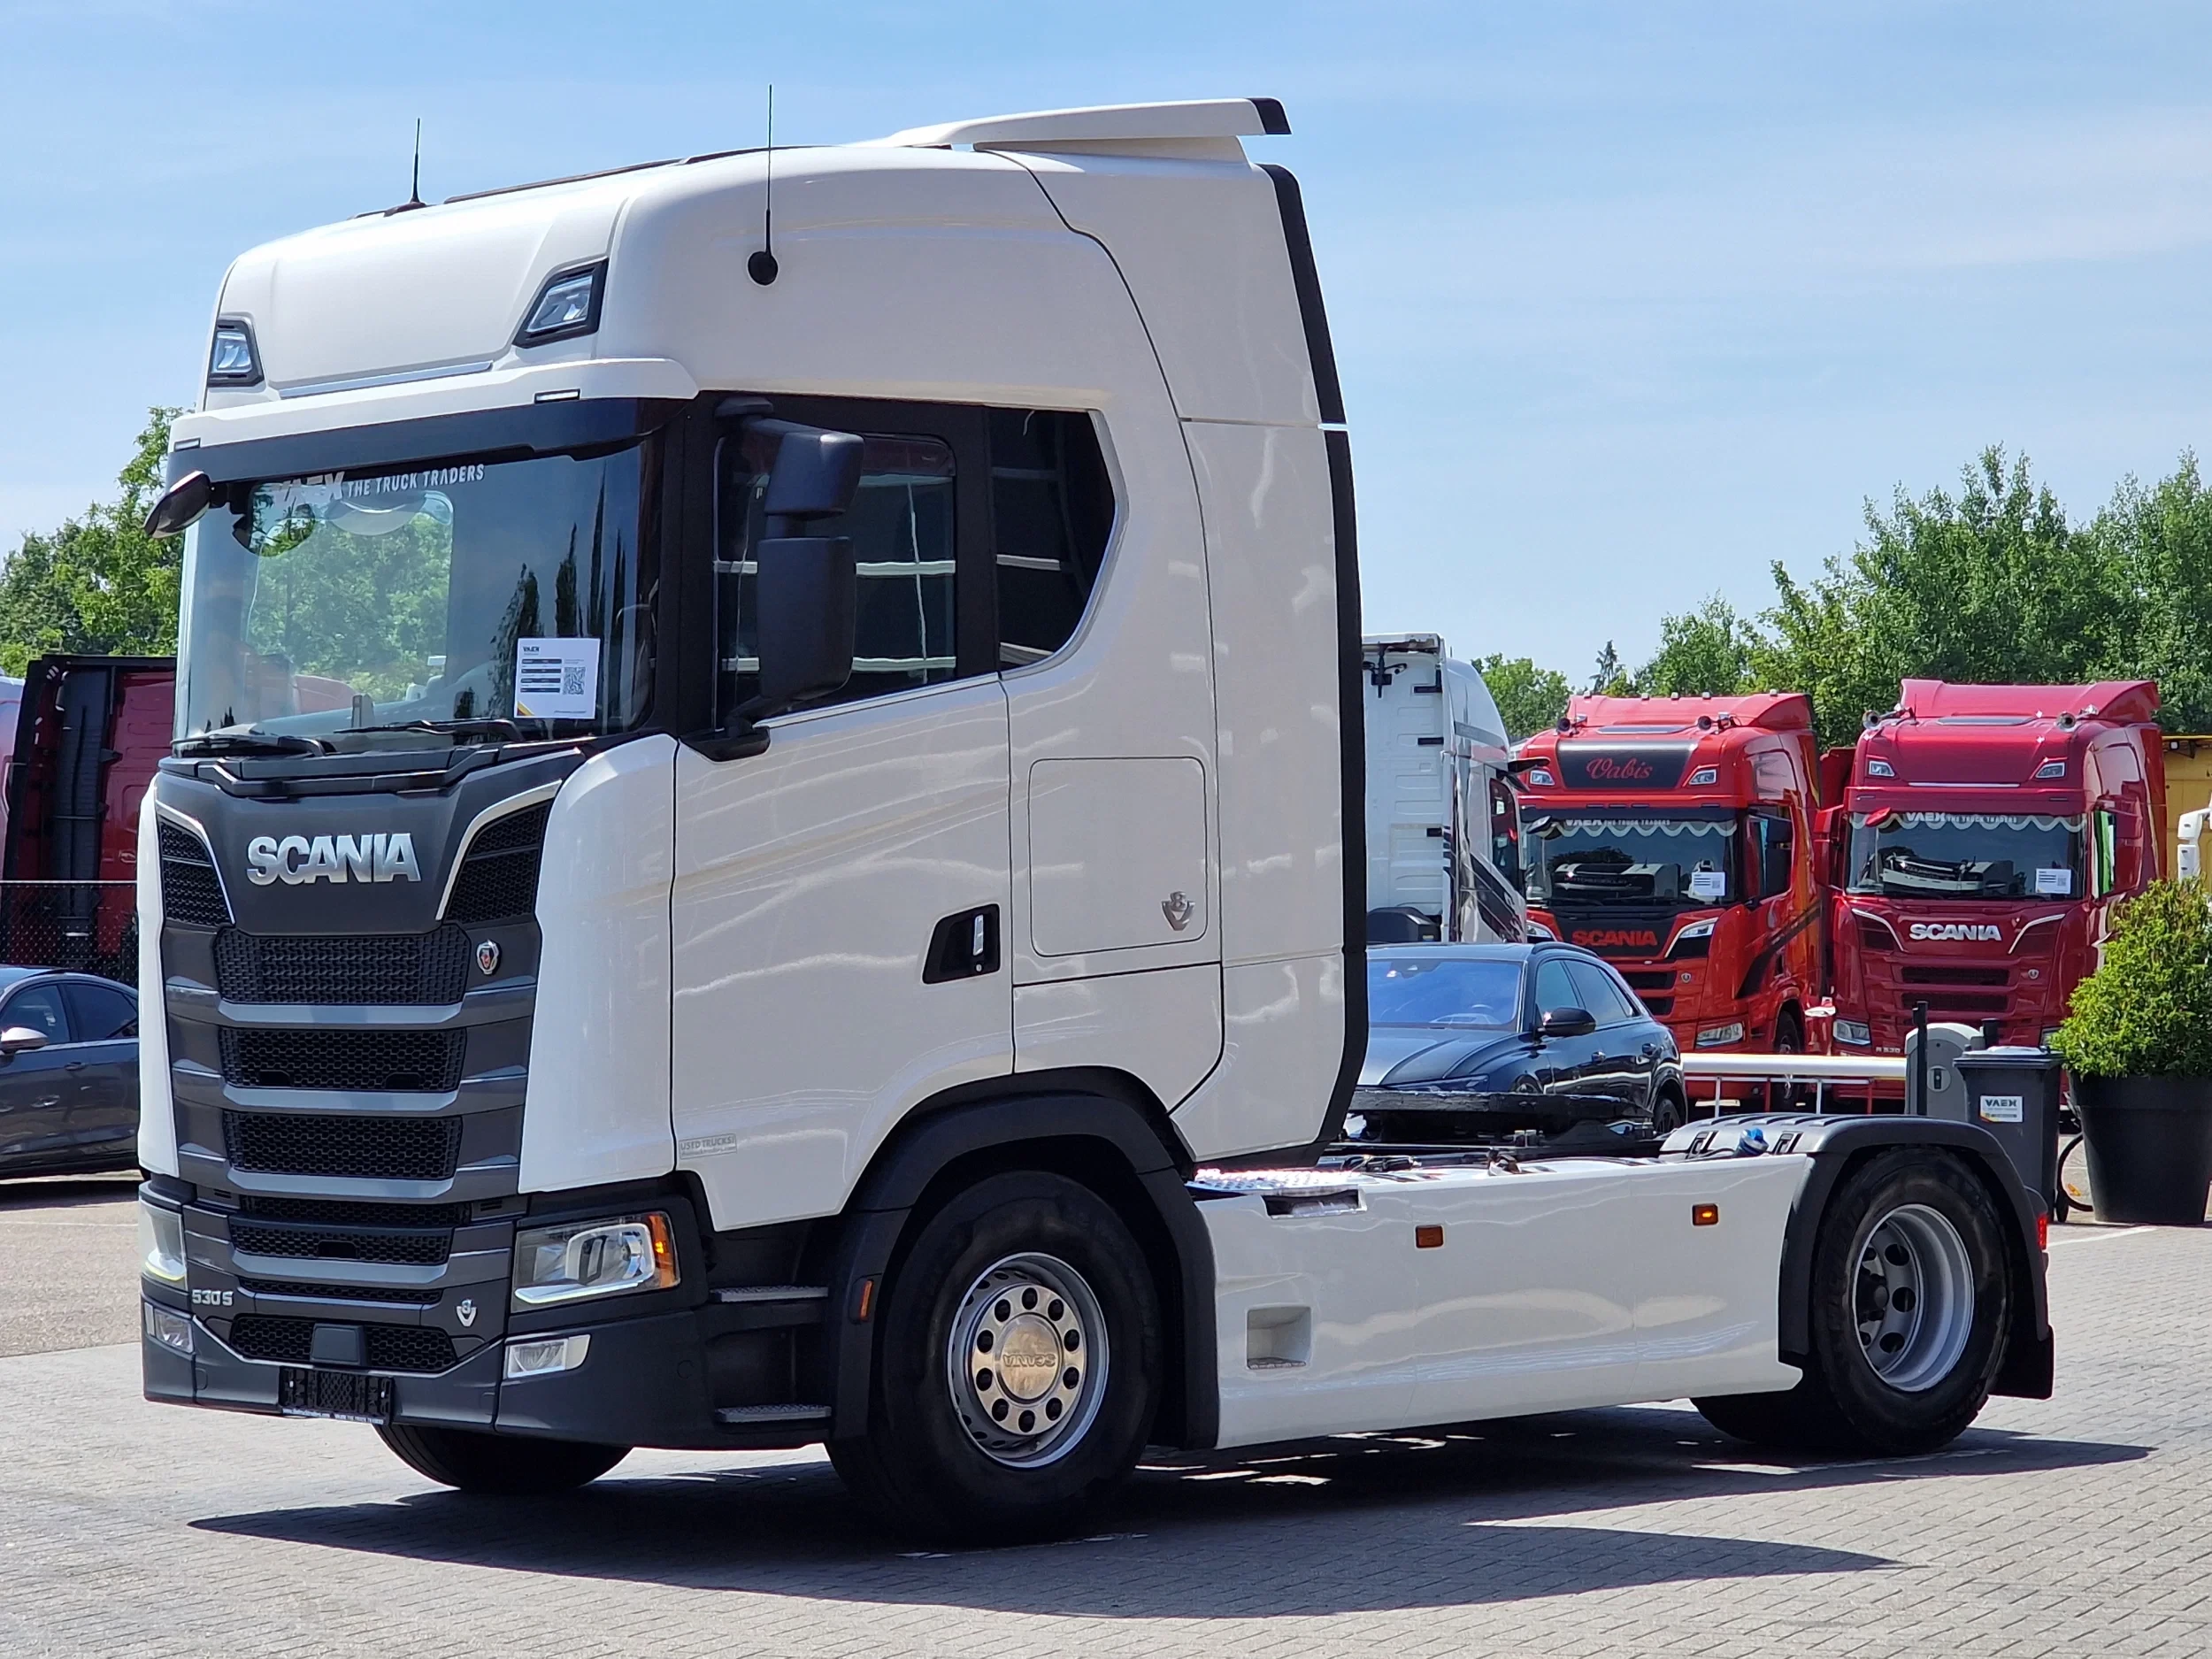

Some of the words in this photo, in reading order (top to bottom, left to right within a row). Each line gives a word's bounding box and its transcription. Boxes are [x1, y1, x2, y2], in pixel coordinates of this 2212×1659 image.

[348, 480, 370, 497] THE
[376, 472, 418, 494] TRUCK
[424, 464, 485, 488] TRADERS
[1586, 757, 1654, 779] Vabis
[1906, 811, 1946, 822] VAEX
[247, 833, 421, 885] SCANIA
[1571, 930, 1658, 946] SCANIA
[1909, 923, 2002, 942] SCANIA
[1002, 1354, 1056, 1367] SCANIA
